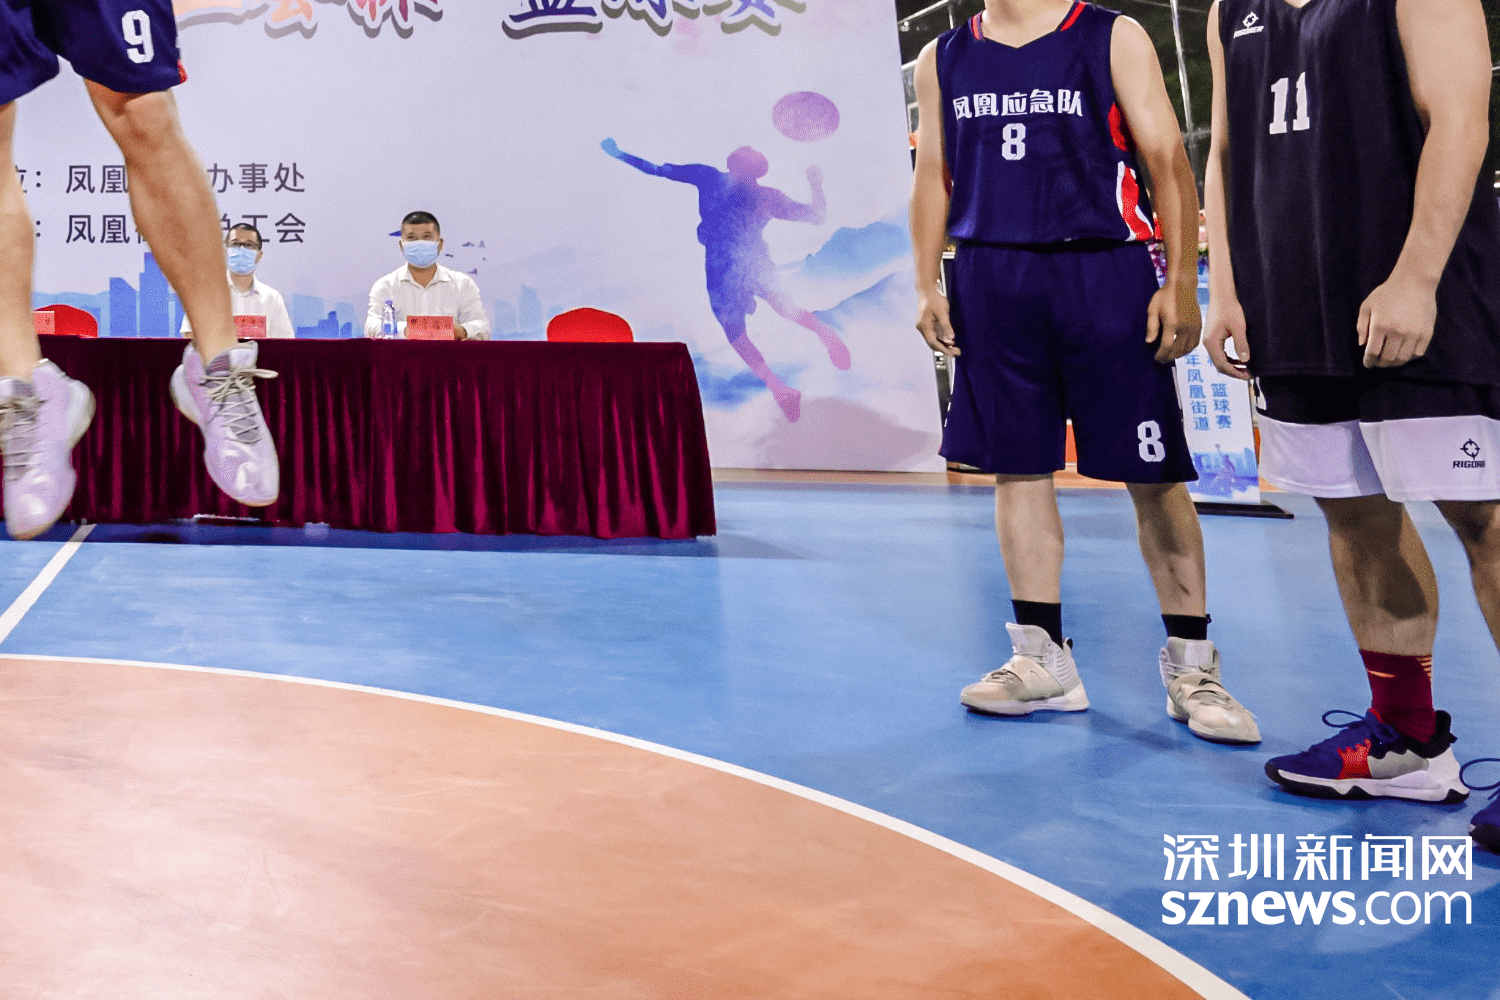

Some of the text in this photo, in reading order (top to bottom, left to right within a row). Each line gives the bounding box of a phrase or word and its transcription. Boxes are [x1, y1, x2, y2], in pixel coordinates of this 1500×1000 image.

[122, 9, 155, 64] 9
[953, 88, 1083, 121] 凤凰应急队
[1269, 71, 1310, 135] 11
[1002, 122, 1026, 160] 8
[1137, 420, 1165, 462] 8
